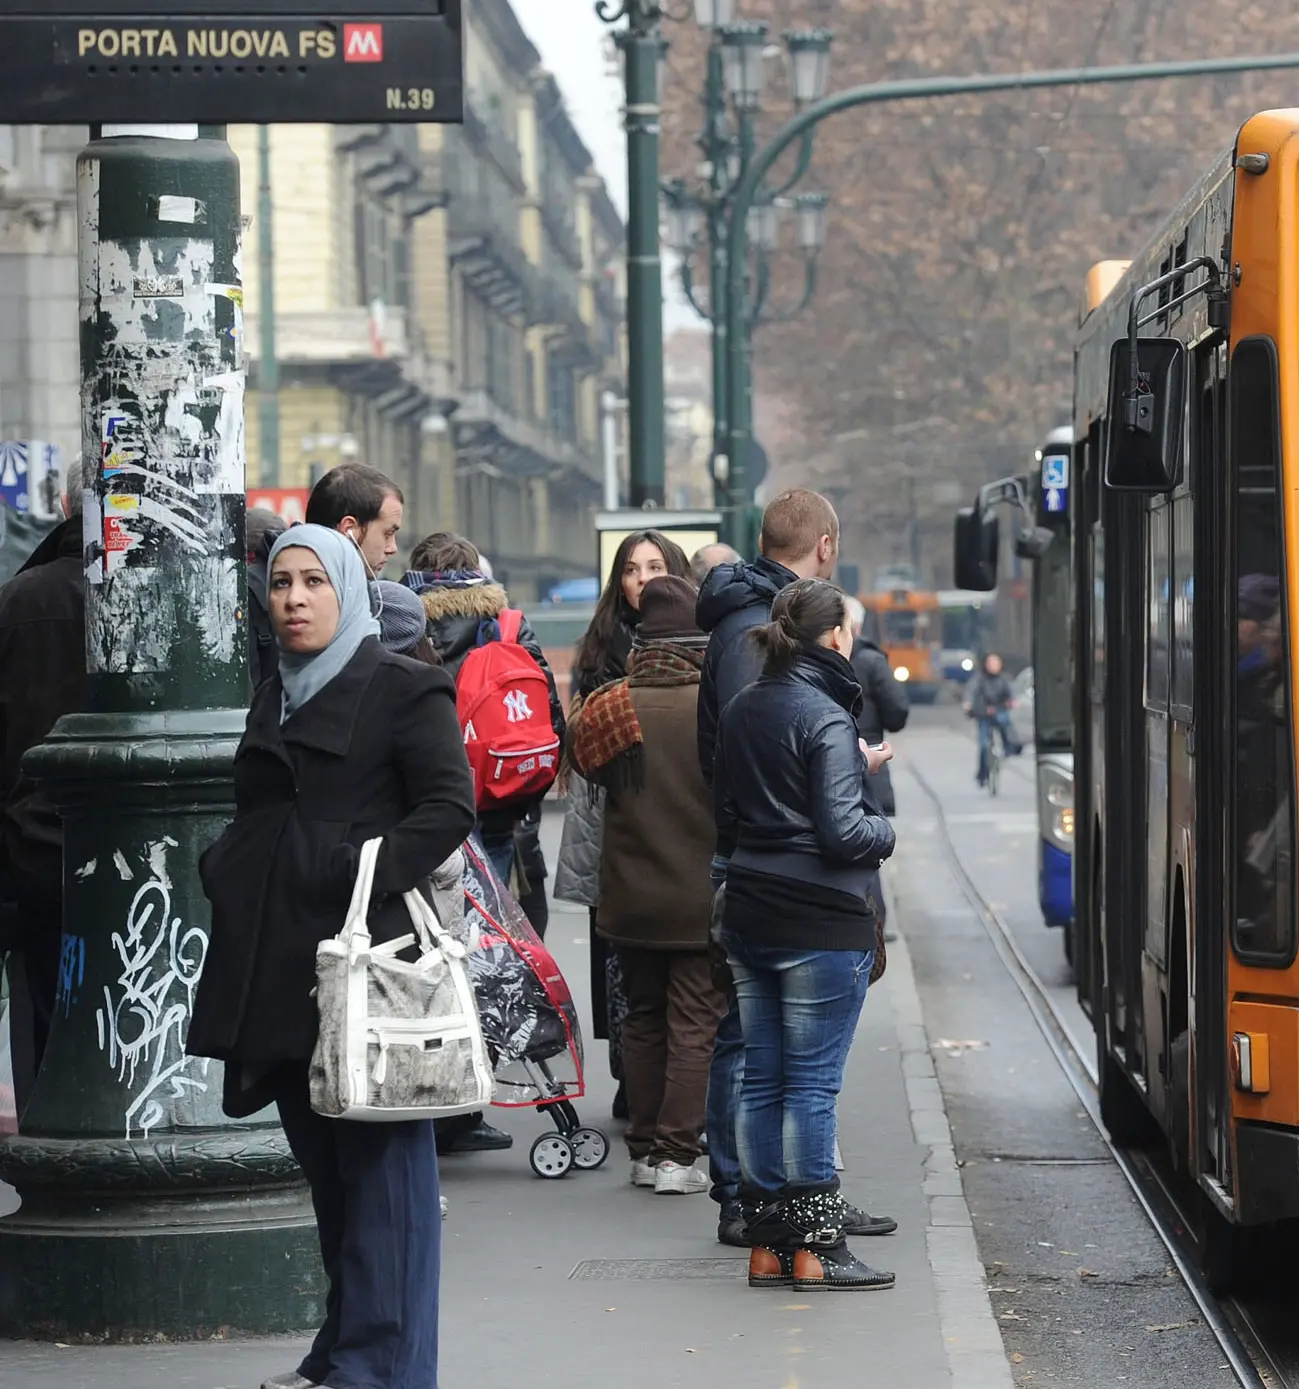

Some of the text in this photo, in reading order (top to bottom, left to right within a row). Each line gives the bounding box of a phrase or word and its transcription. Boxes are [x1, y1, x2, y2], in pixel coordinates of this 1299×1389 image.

[78, 29, 380, 58] PORTA NUOVA FS M
[386, 88, 435, 110] N.39
